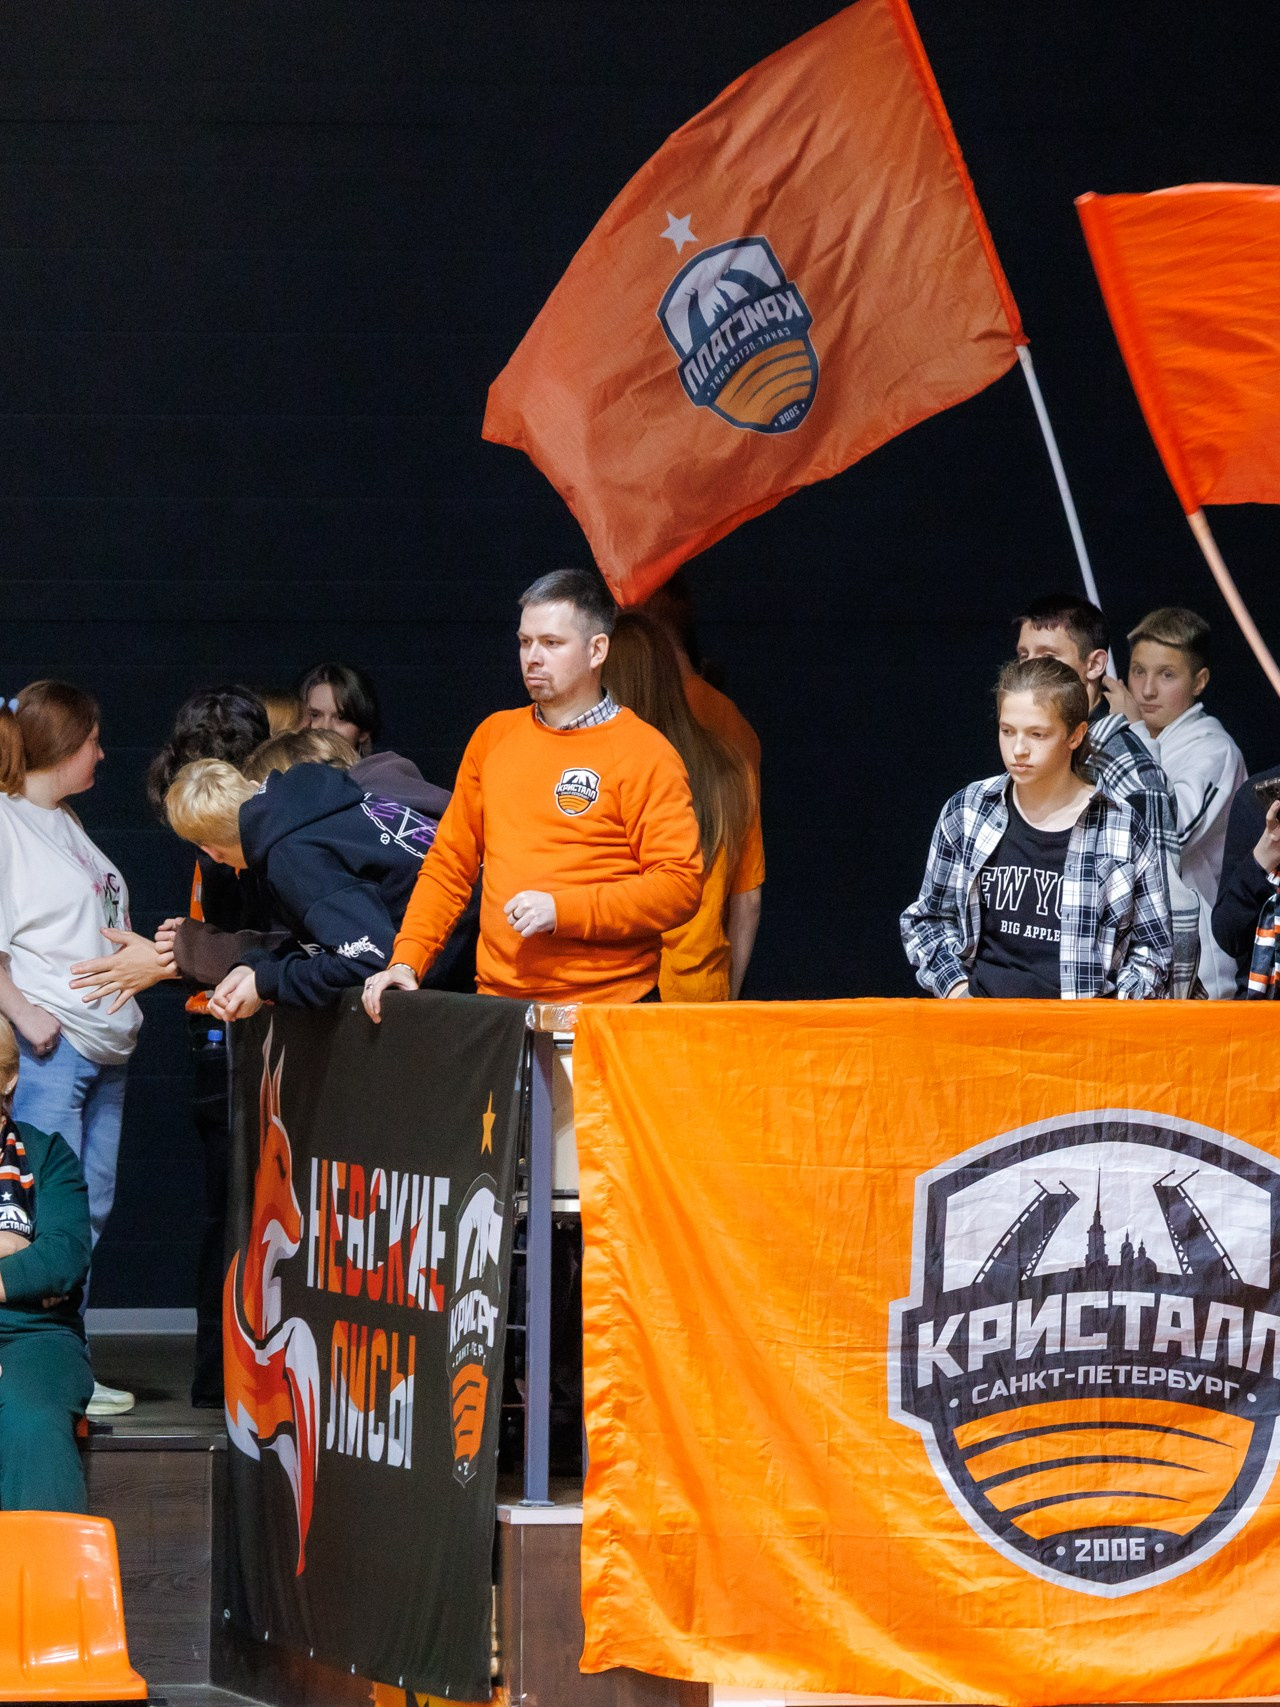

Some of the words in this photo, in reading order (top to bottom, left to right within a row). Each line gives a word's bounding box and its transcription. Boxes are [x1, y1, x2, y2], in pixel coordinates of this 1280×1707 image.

[980, 866, 1031, 911] EW
[1000, 920, 1020, 935] BIG
[1023, 925, 1061, 942] APPLE
[307, 1157, 450, 1313] НЕВСКИЕ
[326, 1319, 417, 1470] ЛИСЫ
[971, 1364, 1240, 1405] САНКТ-ПЕТЕРБУРГ
[1075, 1538, 1146, 1562] 2006
